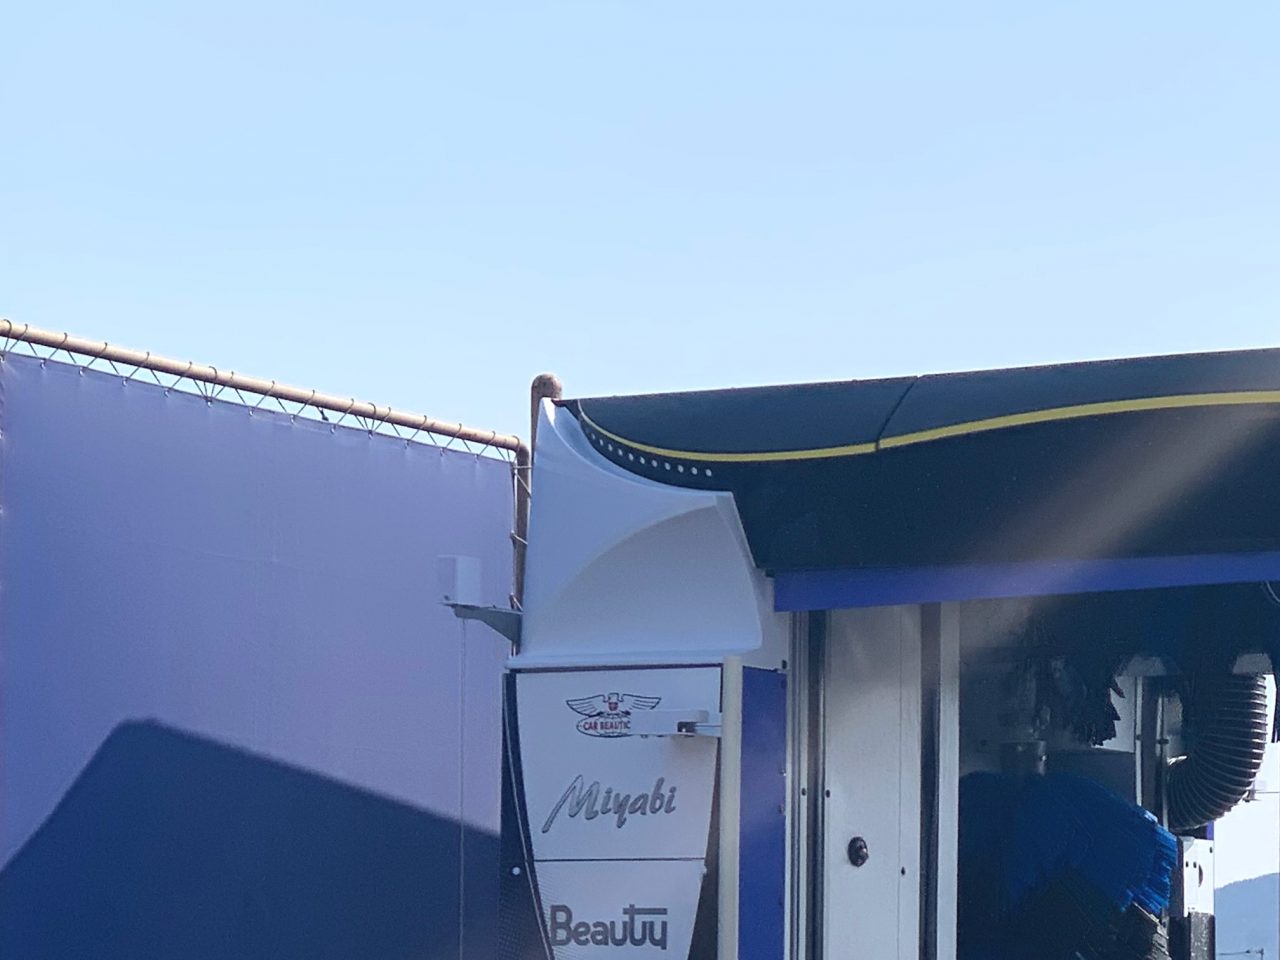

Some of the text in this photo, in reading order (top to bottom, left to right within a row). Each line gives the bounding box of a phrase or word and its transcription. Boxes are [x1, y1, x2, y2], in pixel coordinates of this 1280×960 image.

[583, 721, 631, 731] CAR BEAUTIC
[541, 774, 677, 833] Miyabi
[550, 904, 668, 950] Beauty
